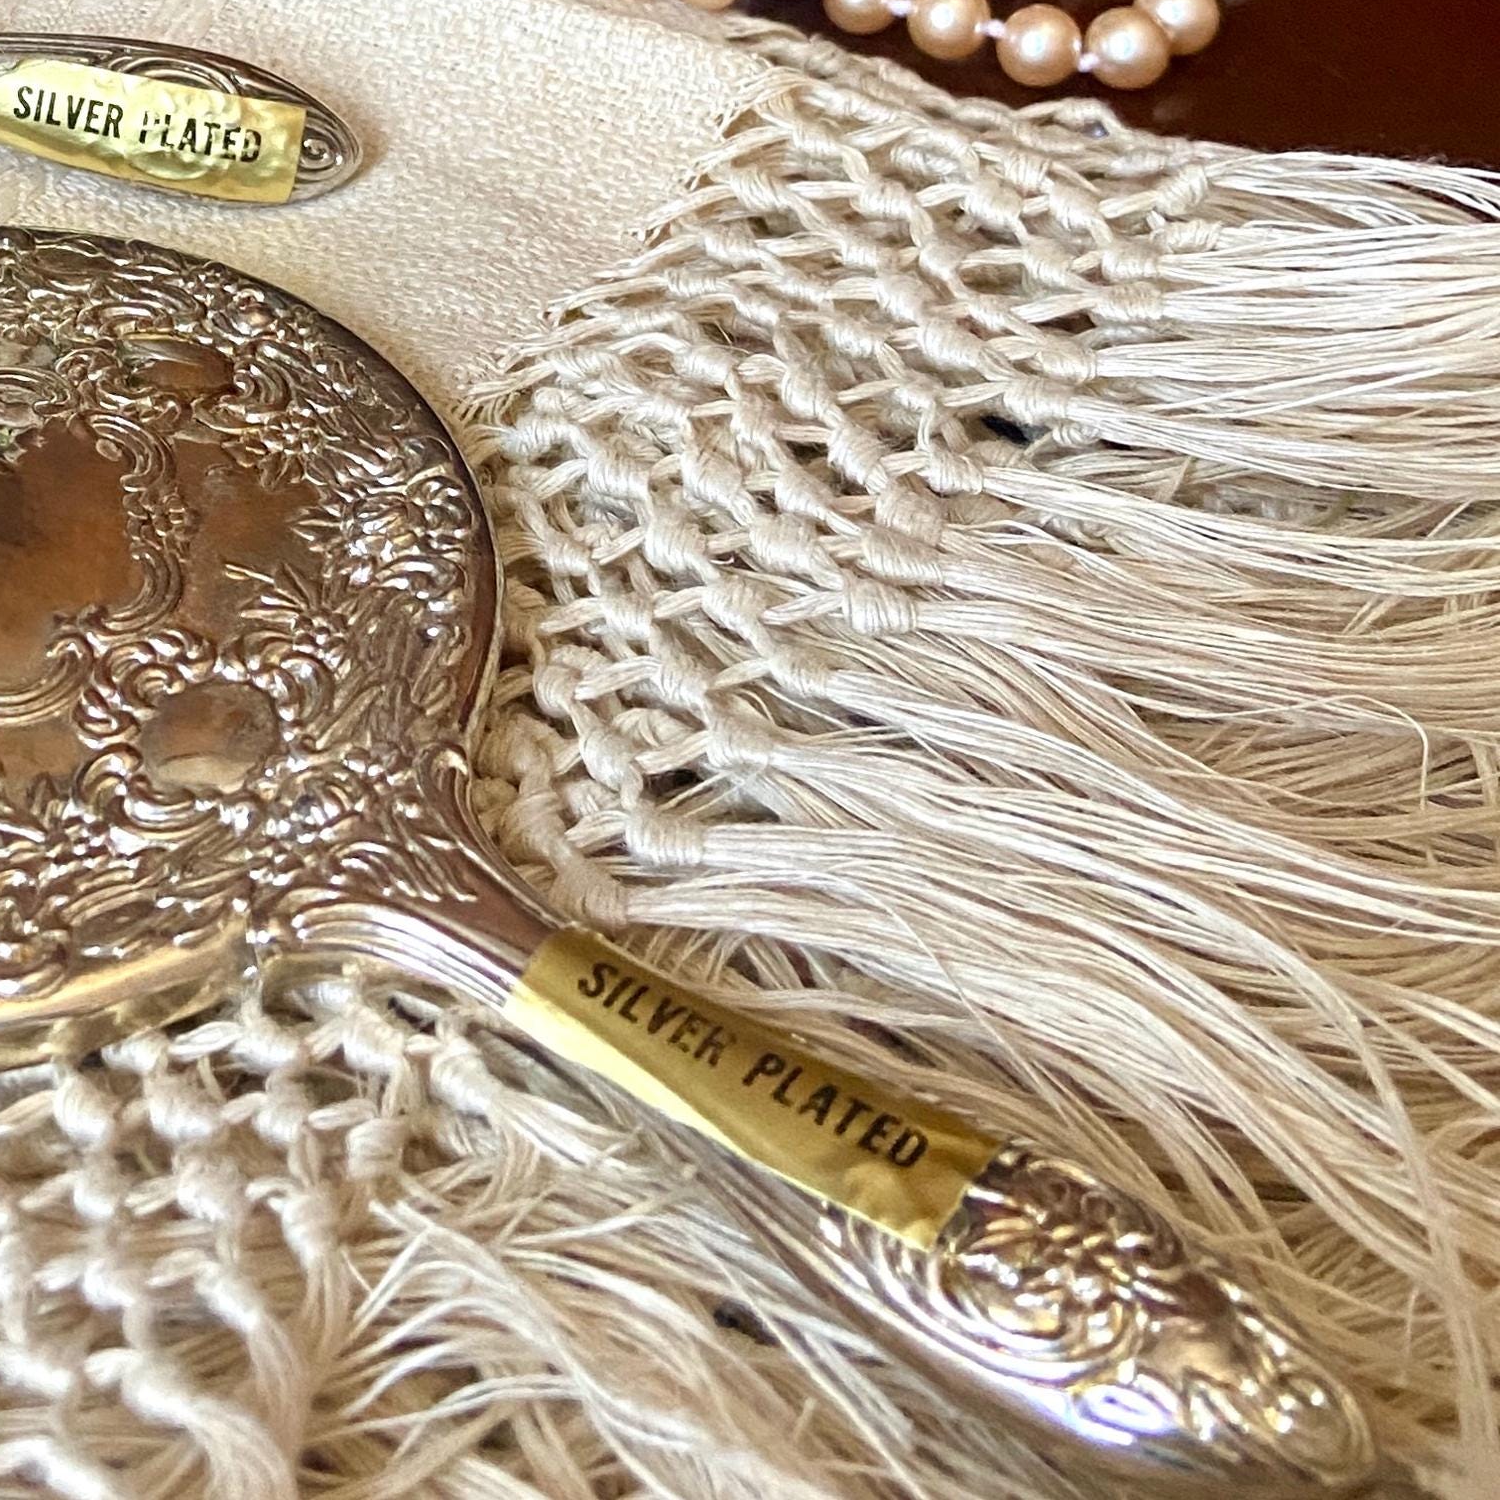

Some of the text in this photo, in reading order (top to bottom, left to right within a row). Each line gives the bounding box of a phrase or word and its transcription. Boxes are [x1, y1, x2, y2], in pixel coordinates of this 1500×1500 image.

[13, 86, 261, 162] SILVER PLATED
[578, 962, 929, 1167] SILVER PLATED
